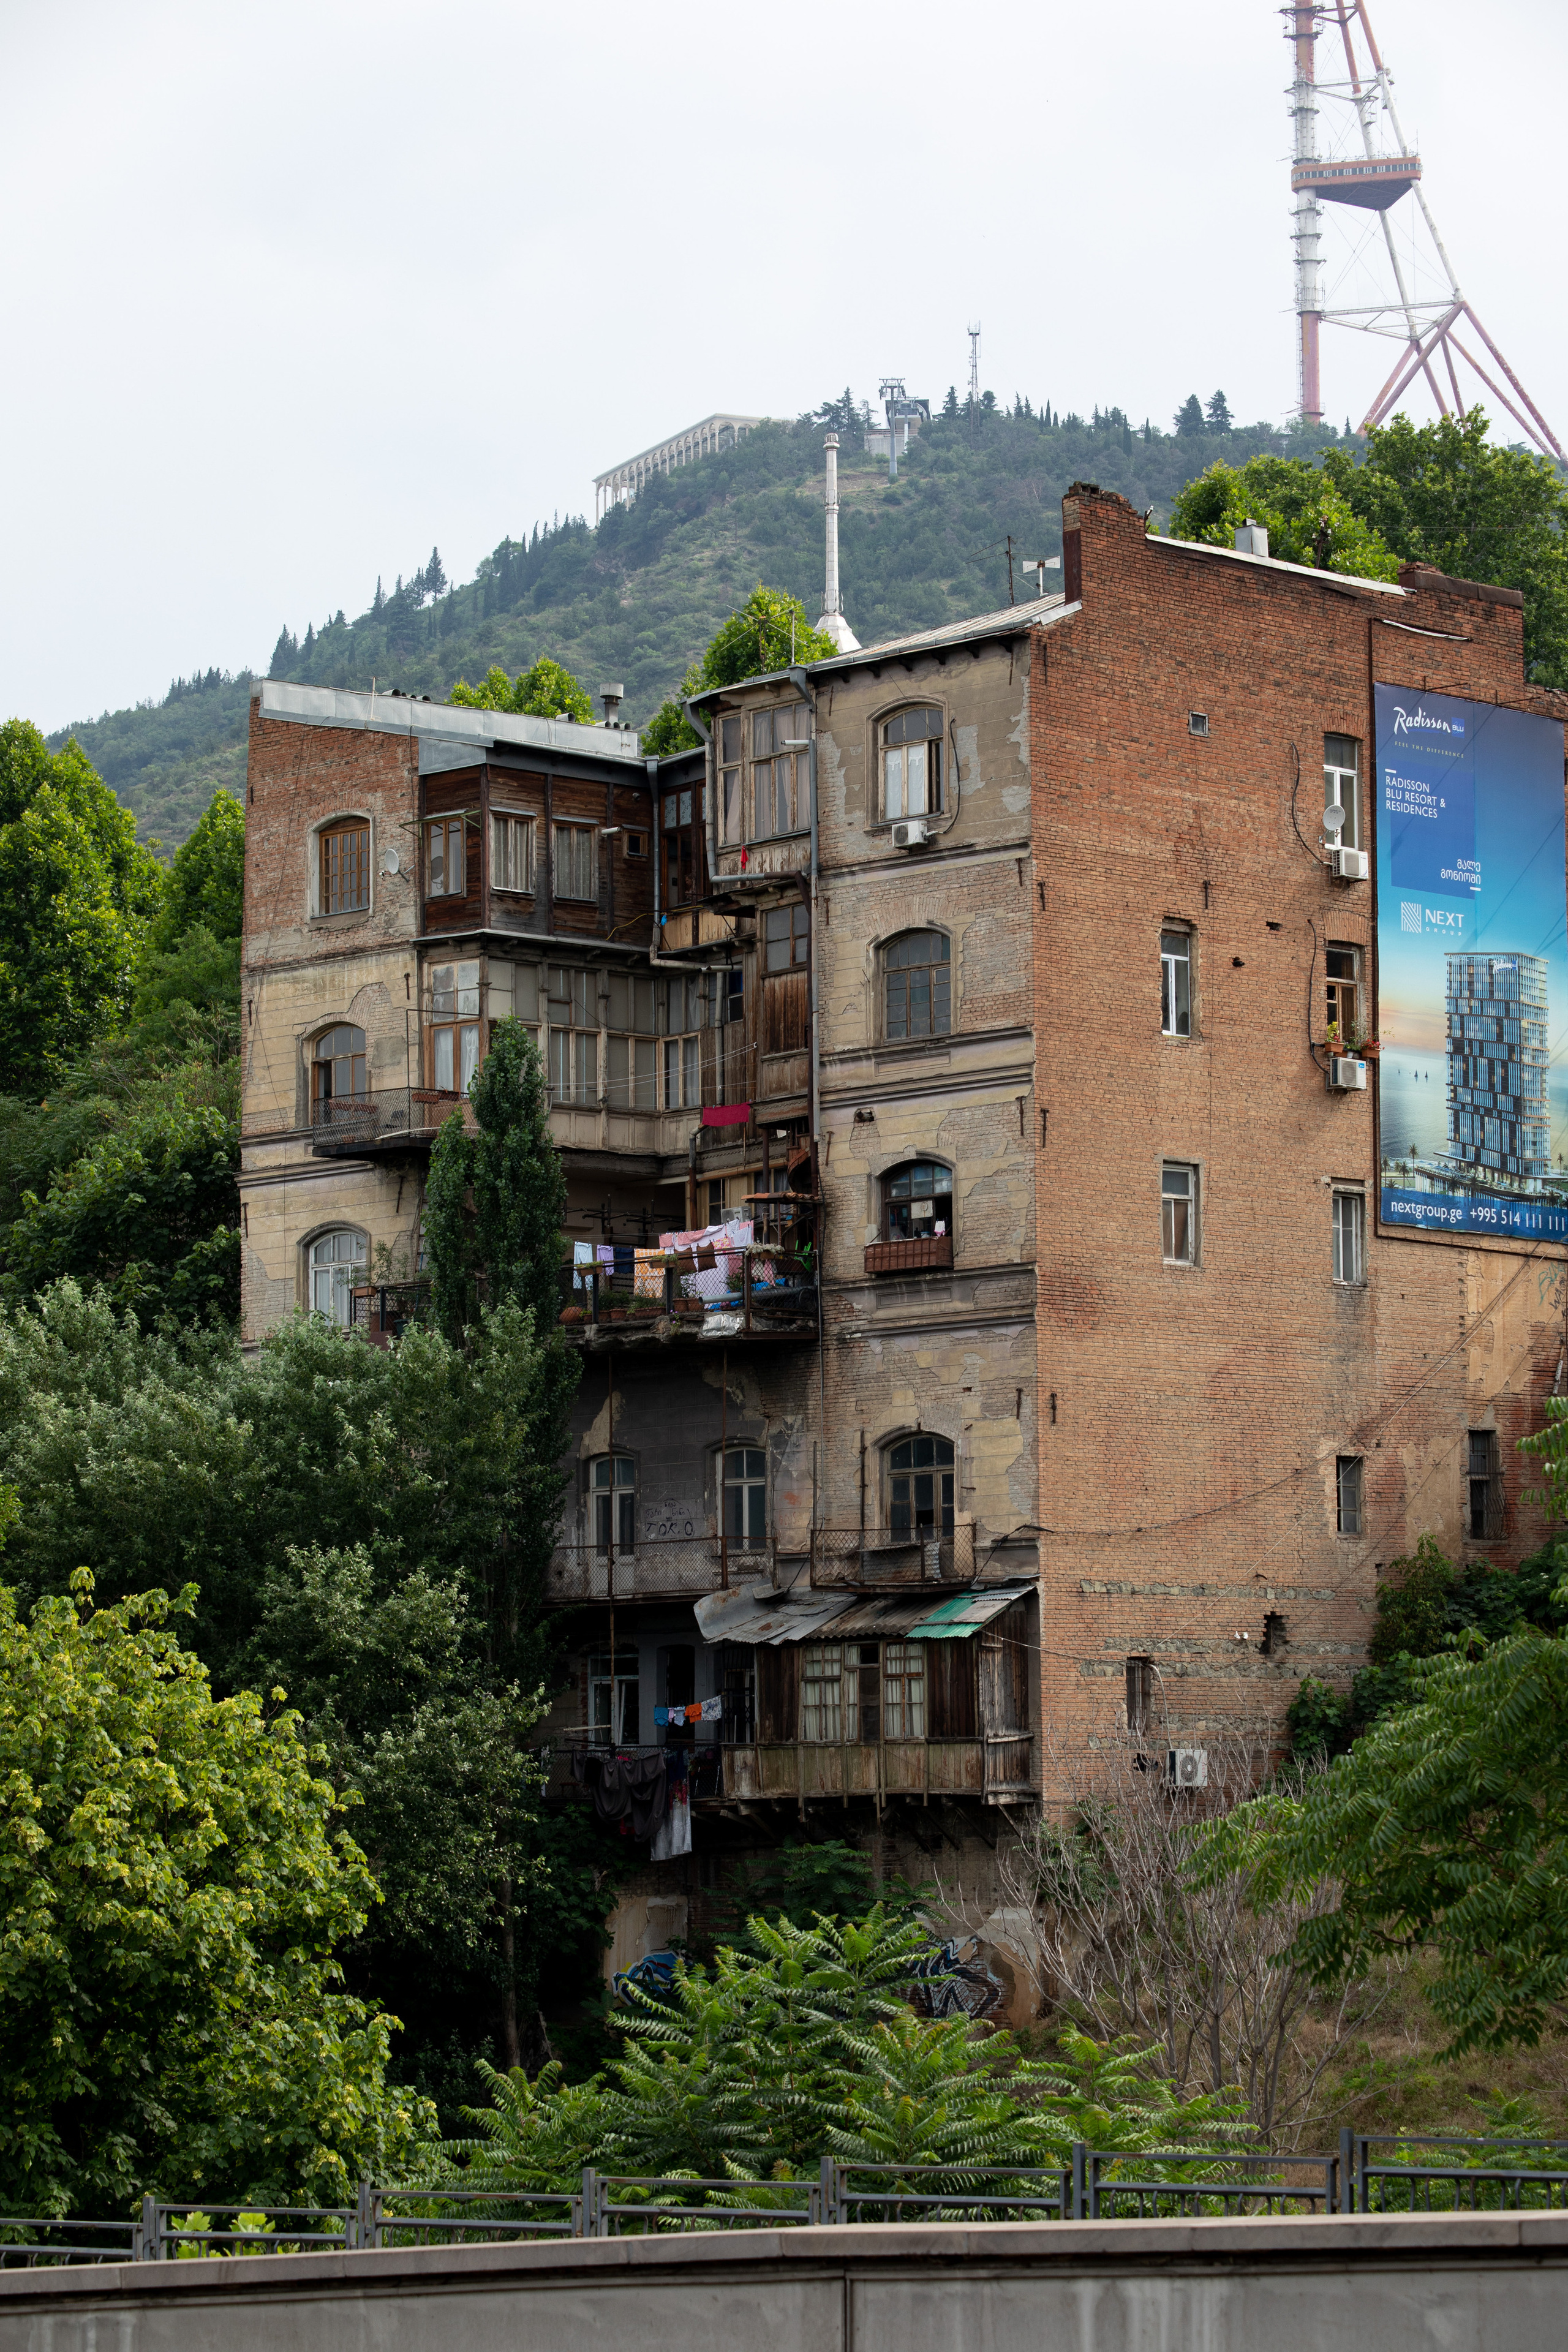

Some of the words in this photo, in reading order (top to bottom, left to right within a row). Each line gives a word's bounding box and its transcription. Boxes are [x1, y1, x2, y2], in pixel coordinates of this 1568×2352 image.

[1393, 706, 1450, 734] Radisson
[1427, 747, 1464, 758] DIFFERENCE
[1385, 775, 1429, 793] RADISSON
[1386, 788, 1401, 799] BLU
[1405, 791, 1437, 806] RESORT
[1440, 798, 1446, 808] &
[1386, 800, 1438, 818] RESIDENCES
[1457, 859, 1481, 872] მალე
[1441, 869, 1481, 884] გონიოში
[1425, 908, 1464, 928] NEXT
[1426, 927, 1462, 936] GROUP
[1391, 1201, 1462, 1224] nextgroup.ge
[1470, 1207, 1497, 1223] +995
[1501, 1210, 1520, 1226] 514
[1526, 1213, 1542, 1229] 111
[1549, 1215, 1564, 1231] 111
